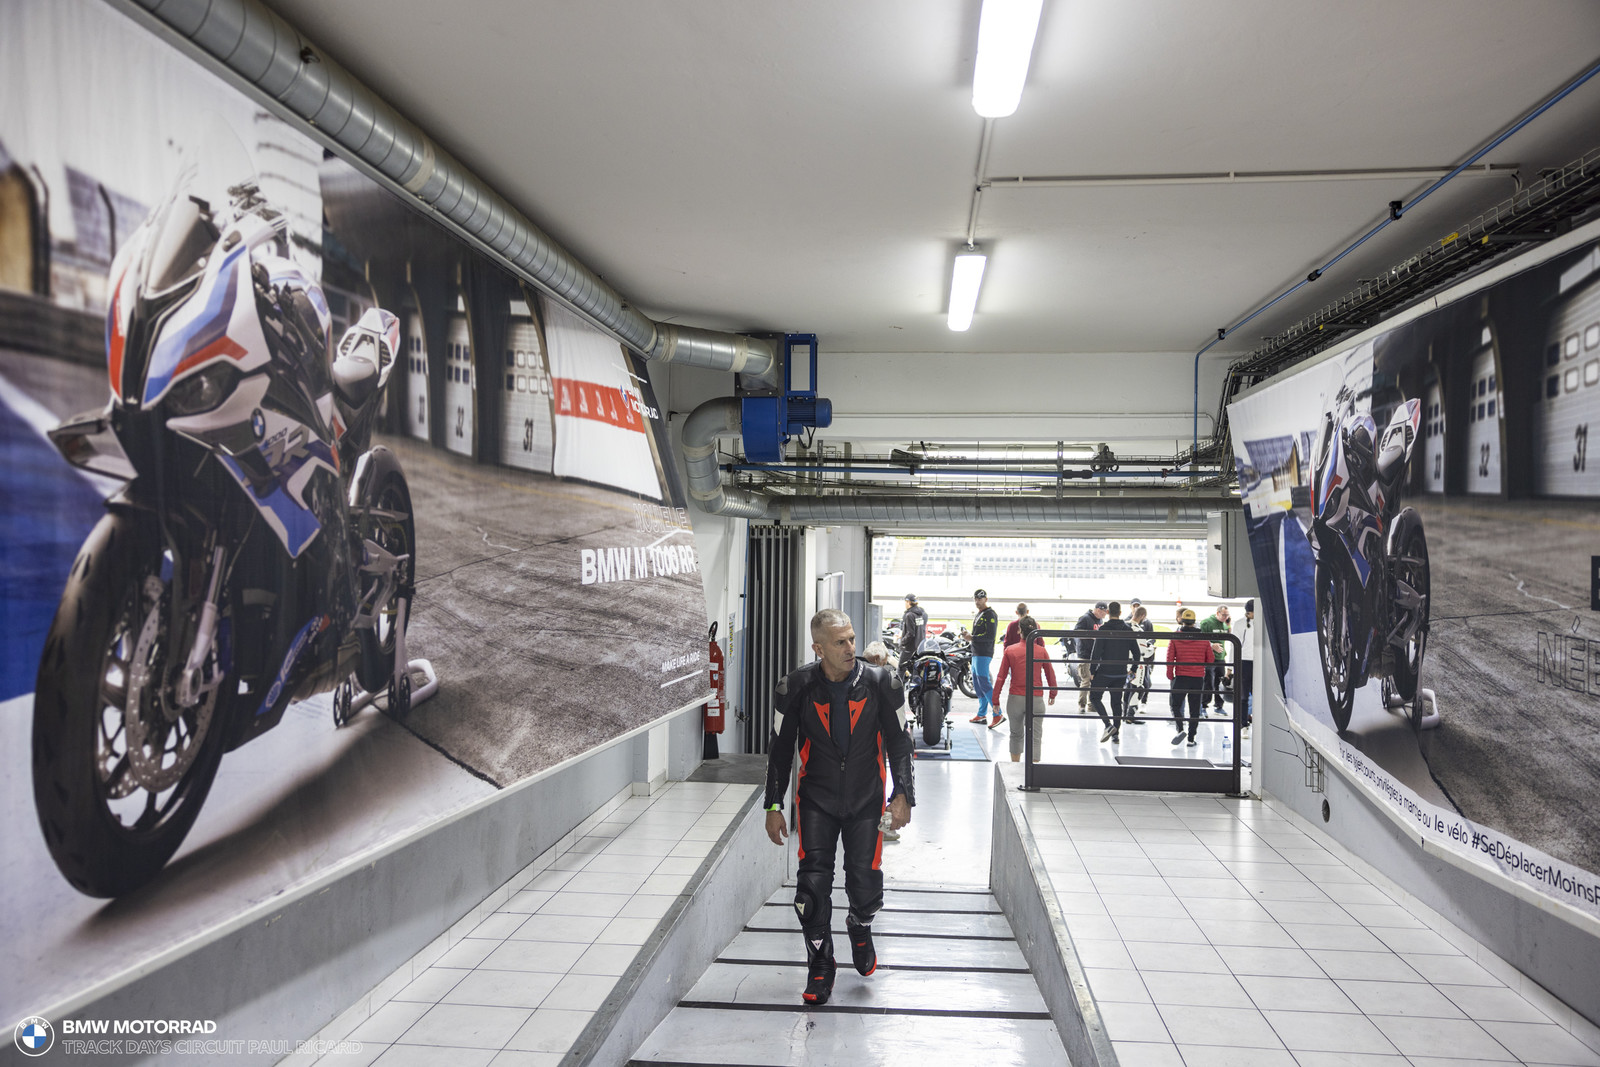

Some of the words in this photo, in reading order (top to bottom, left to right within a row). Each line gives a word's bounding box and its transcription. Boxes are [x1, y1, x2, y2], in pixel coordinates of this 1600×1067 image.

[581, 548, 631, 585] BMW
[634, 546, 648, 579] M
[650, 545, 680, 577] 1000
[678, 545, 697, 573] RR
[1423, 813, 1431, 829] ou
[1434, 814, 1445, 834] le
[1447, 822, 1468, 845] vélo
